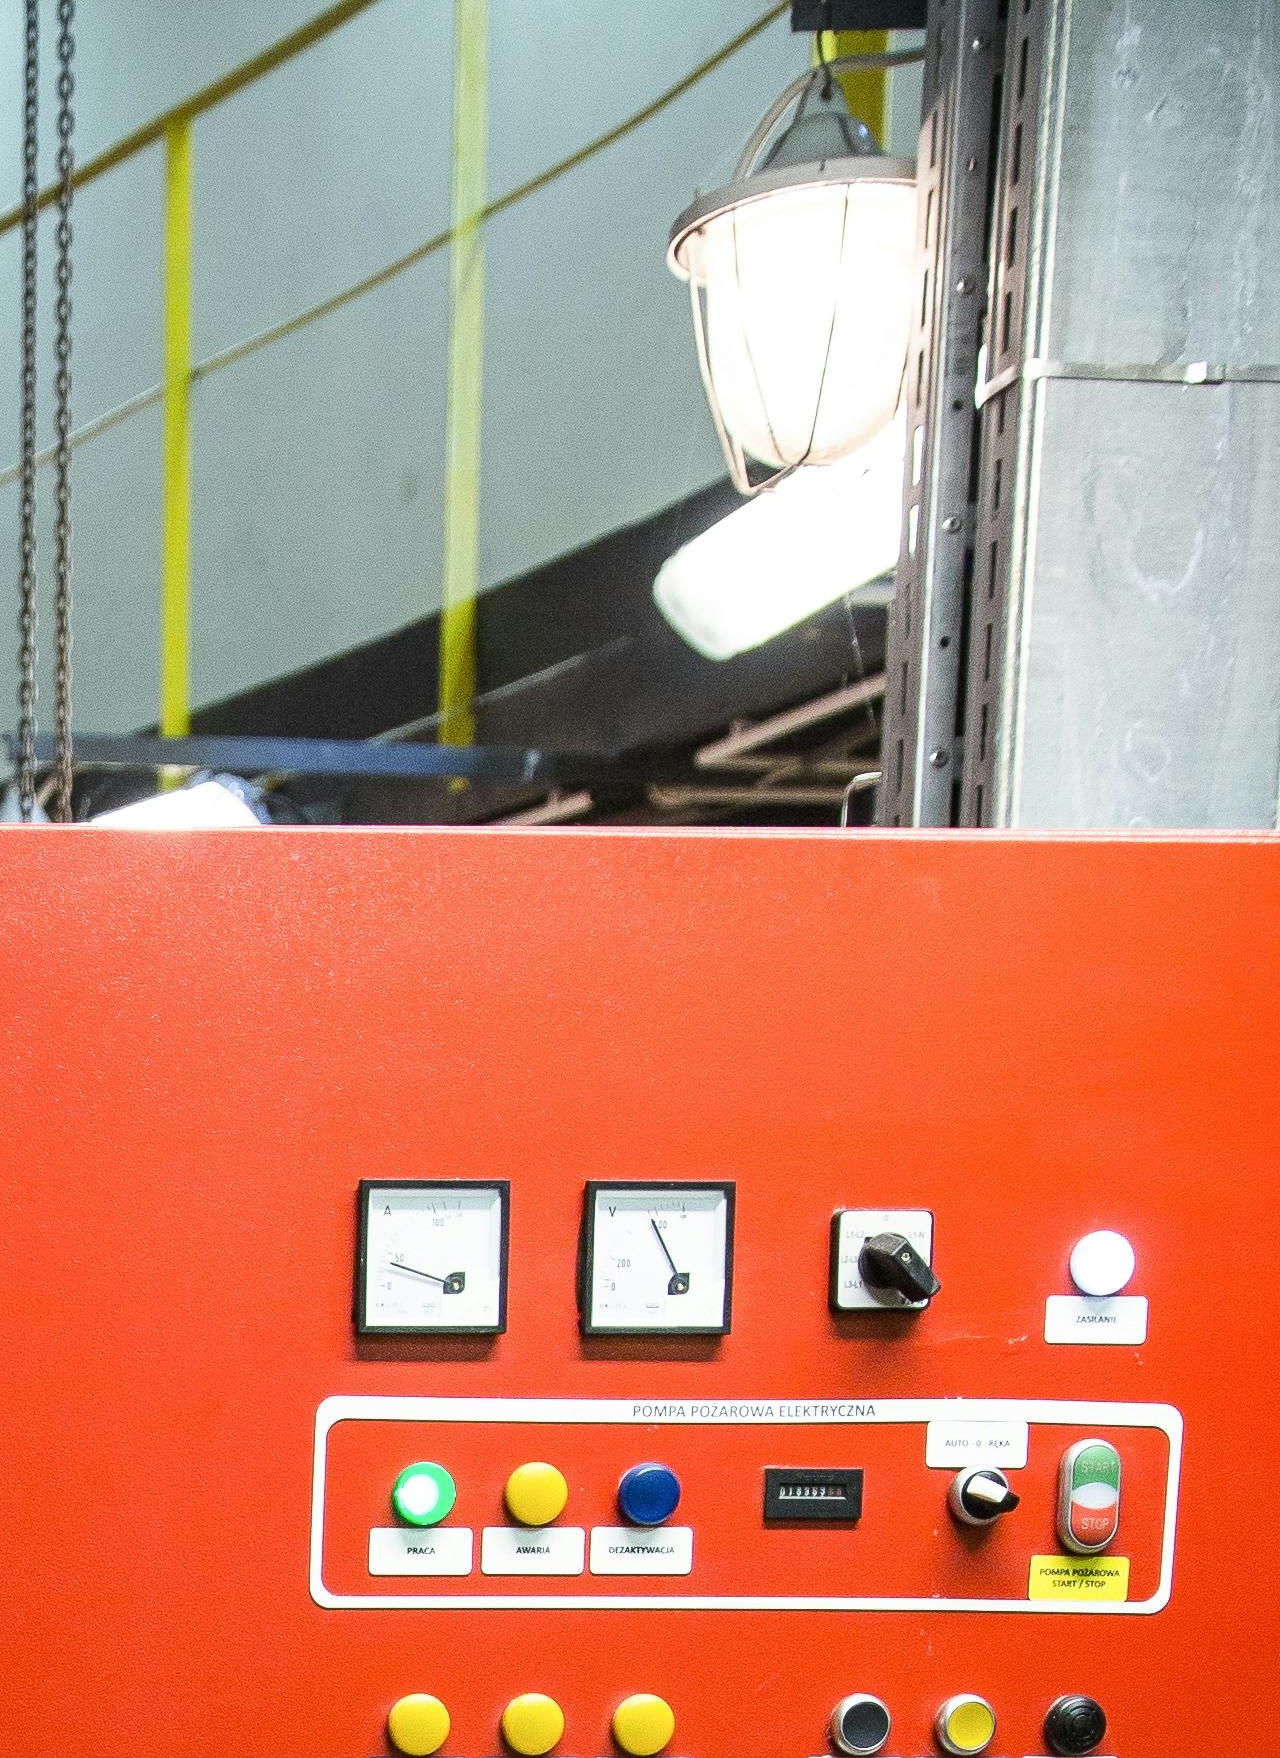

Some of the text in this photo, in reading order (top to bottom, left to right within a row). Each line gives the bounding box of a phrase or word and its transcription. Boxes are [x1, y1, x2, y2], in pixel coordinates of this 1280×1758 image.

[383, 1205, 392, 1216] A
[608, 1206, 617, 1217] V
[432, 1218, 445, 1226] 100
[394, 1253, 405, 1263] 50
[616, 1259, 631, 1268] 200
[632, 1404, 877, 1417] POMPA POŻAROWA ELEKTRYCZNA
[944, 1439, 969, 1447] AUTO
[988, 1439, 1010, 1448] RĘKA
[1080, 1460, 1116, 1473] START
[1080, 1517, 1110, 1530] STOP
[406, 1547, 436, 1555] PRACA
[515, 1546, 551, 1554] AWARIA
[608, 1546, 676, 1555] DEZAKTYWACJA
[1039, 1567, 1120, 1577] POMPA POŻAROWA
[1052, 1580, 1077, 1588] START
[1085, 1580, 1106, 1588] STOP
